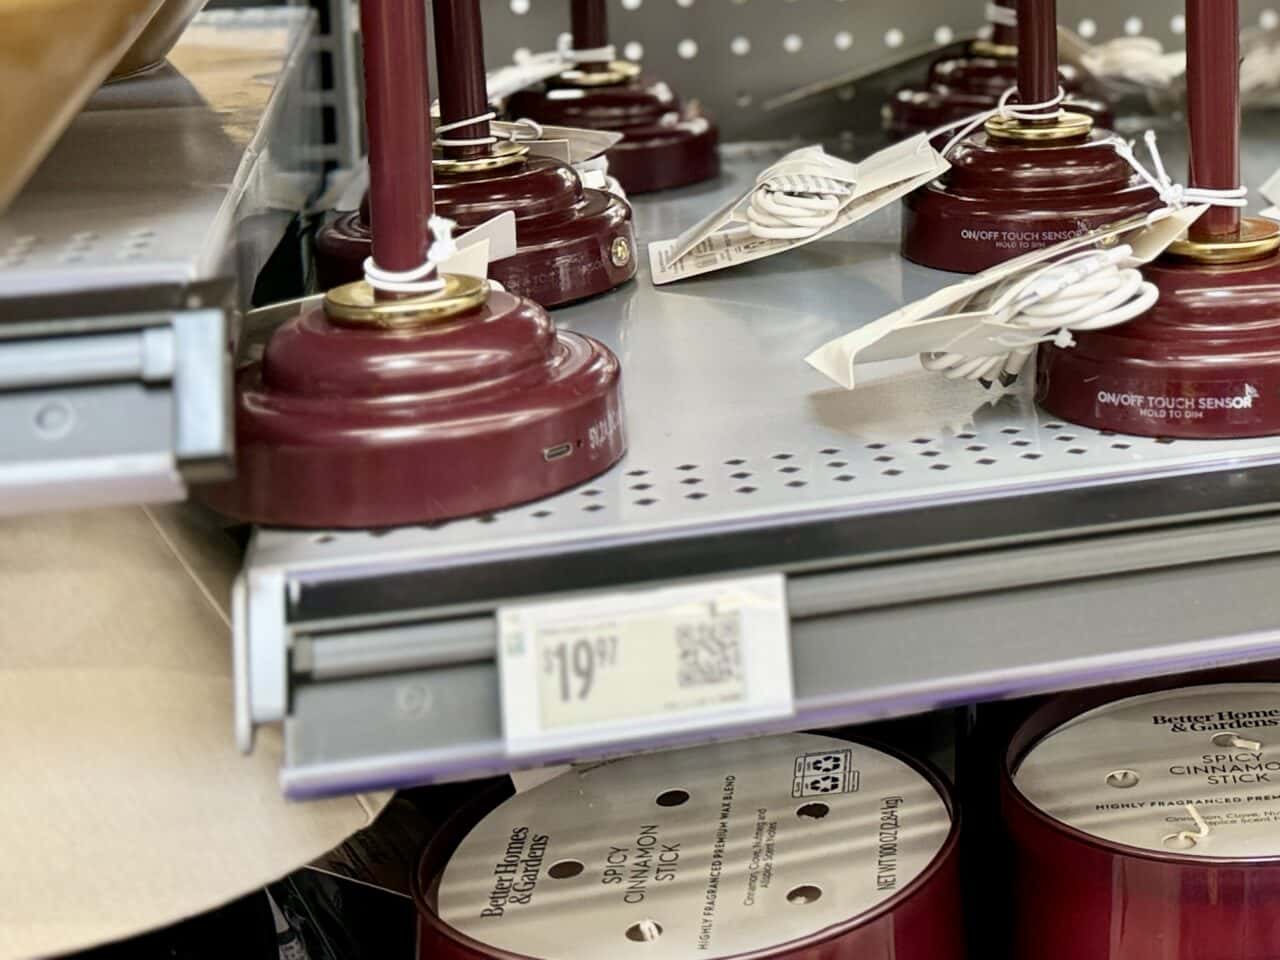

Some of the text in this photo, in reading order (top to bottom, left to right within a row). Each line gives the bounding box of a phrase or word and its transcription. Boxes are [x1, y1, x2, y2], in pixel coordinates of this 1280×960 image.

[960, 229, 999, 241] ON/OFF
[1001, 231, 1039, 241] TOUCH
[1097, 391, 1252, 409] ON/OFF TOUCH SENSOR
[1140, 409, 1166, 418] HOLD
[1169, 409, 1182, 418] TO
[1152, 714, 1214, 725] Better
[1202, 752, 1263, 764] SPICY
[1208, 773, 1271, 785] STICK
[1095, 801, 1147, 810] HIGHLY
[1149, 796, 1242, 808] FRAGRANCED
[879, 829, 897, 842] OZ
[878, 843, 896, 858] 100
[602, 846, 629, 884] SPICY
[624, 825, 659, 904] CINNAMON
[655, 843, 681, 881] STICK
[698, 775, 736, 950] HIGHLY FRAGRANCED PREMIUM WAX BLEND
[877, 858, 897, 873] WT
[480, 826, 529, 919] Better Homes
[877, 875, 896, 891] NET
